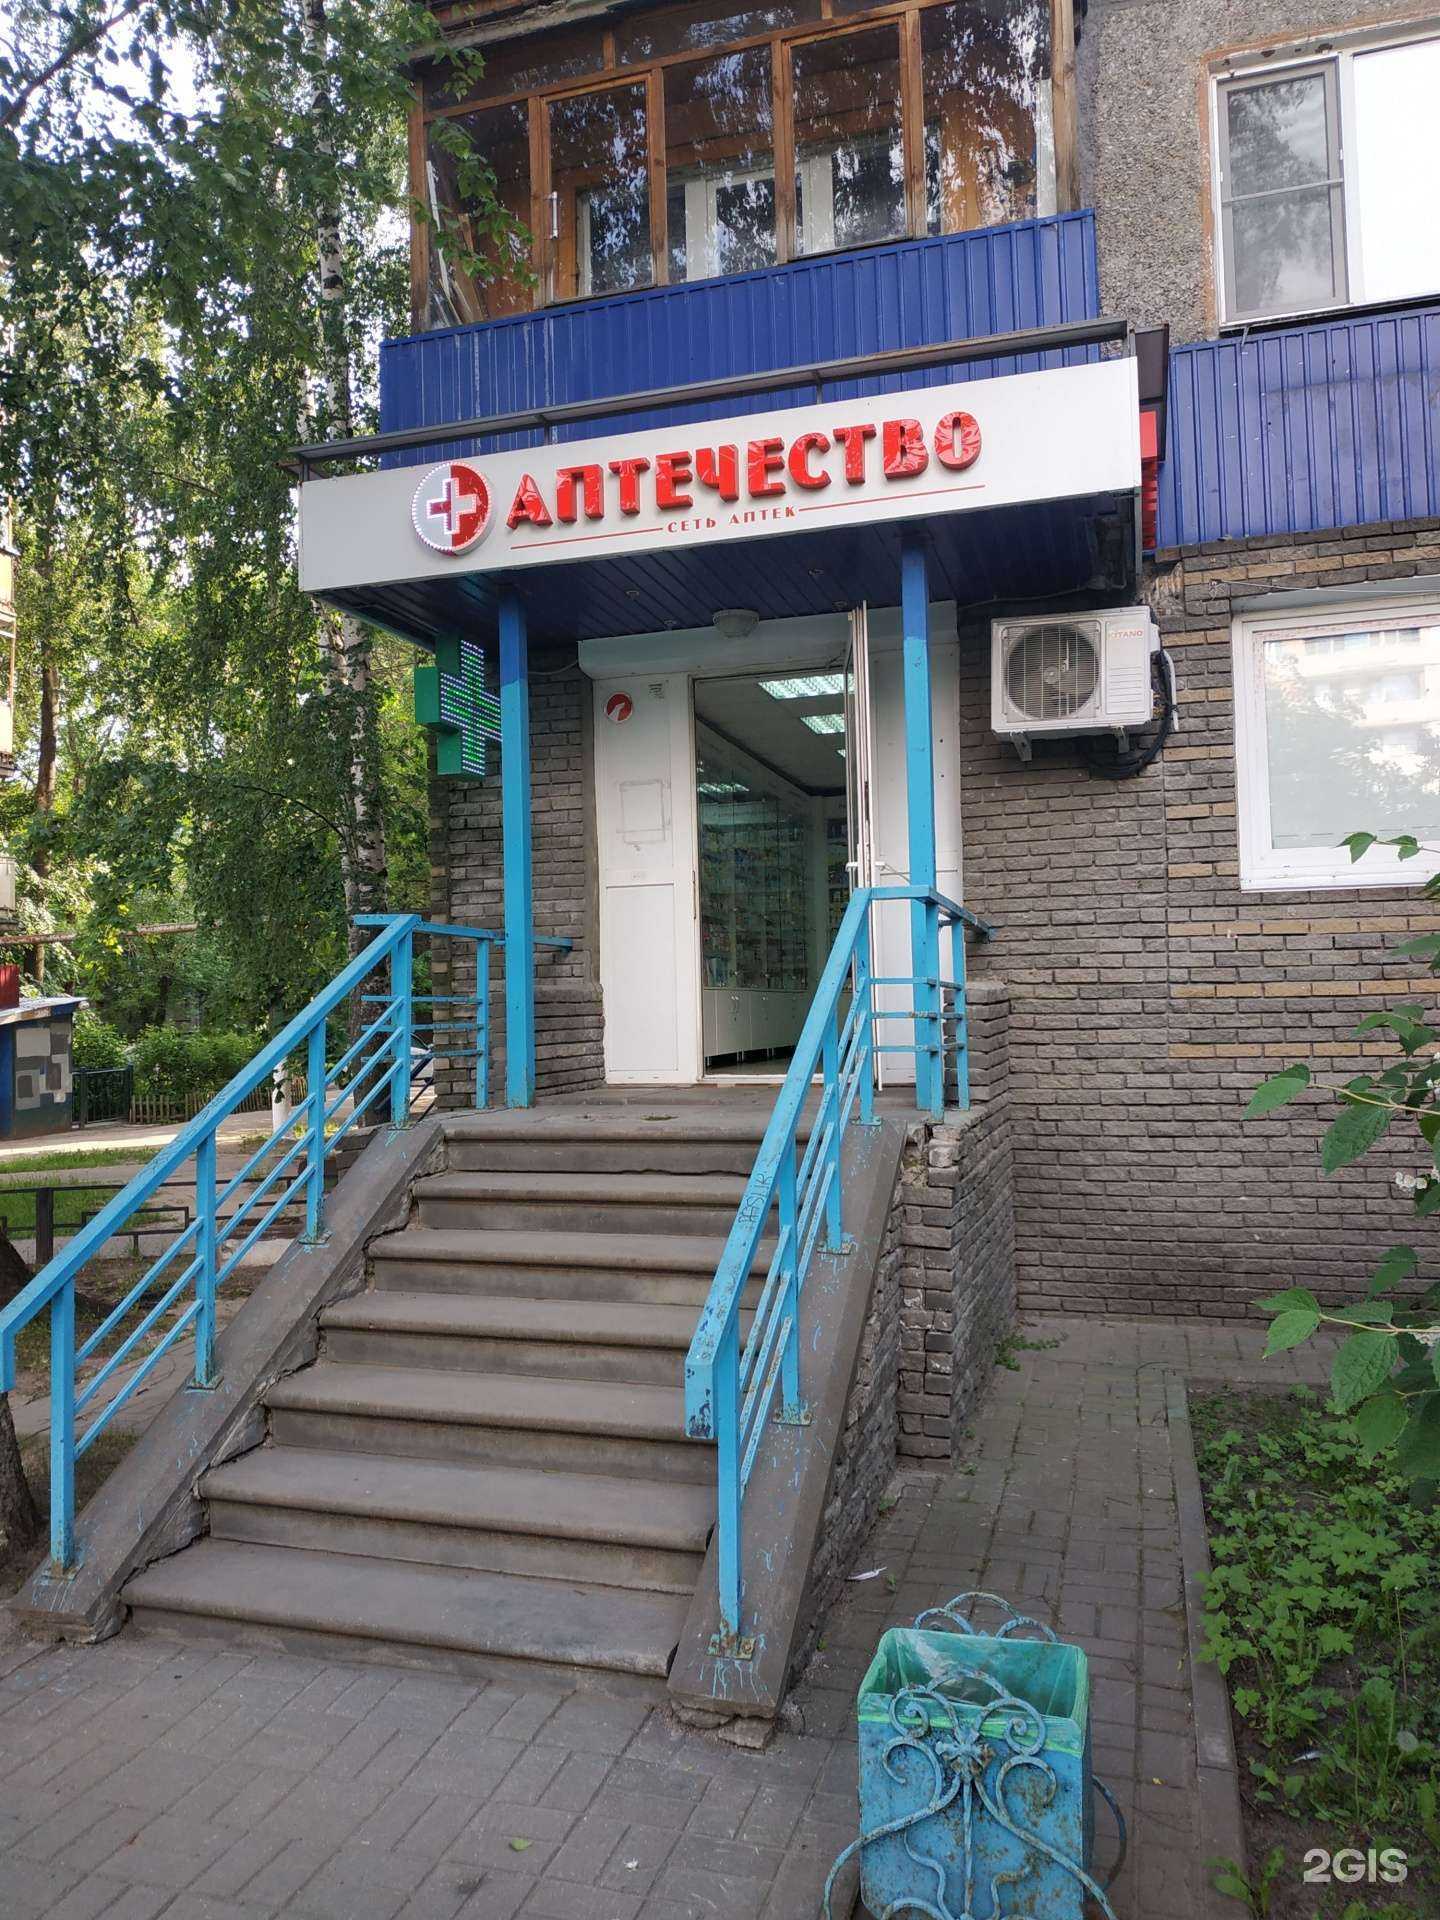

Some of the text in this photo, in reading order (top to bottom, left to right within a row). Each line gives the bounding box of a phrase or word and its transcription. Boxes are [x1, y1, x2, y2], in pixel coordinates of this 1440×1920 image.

[506, 411, 982, 529] АПТЕЧЕСТВО
[667, 506, 796, 533] СЕТЬ АПТЕК
